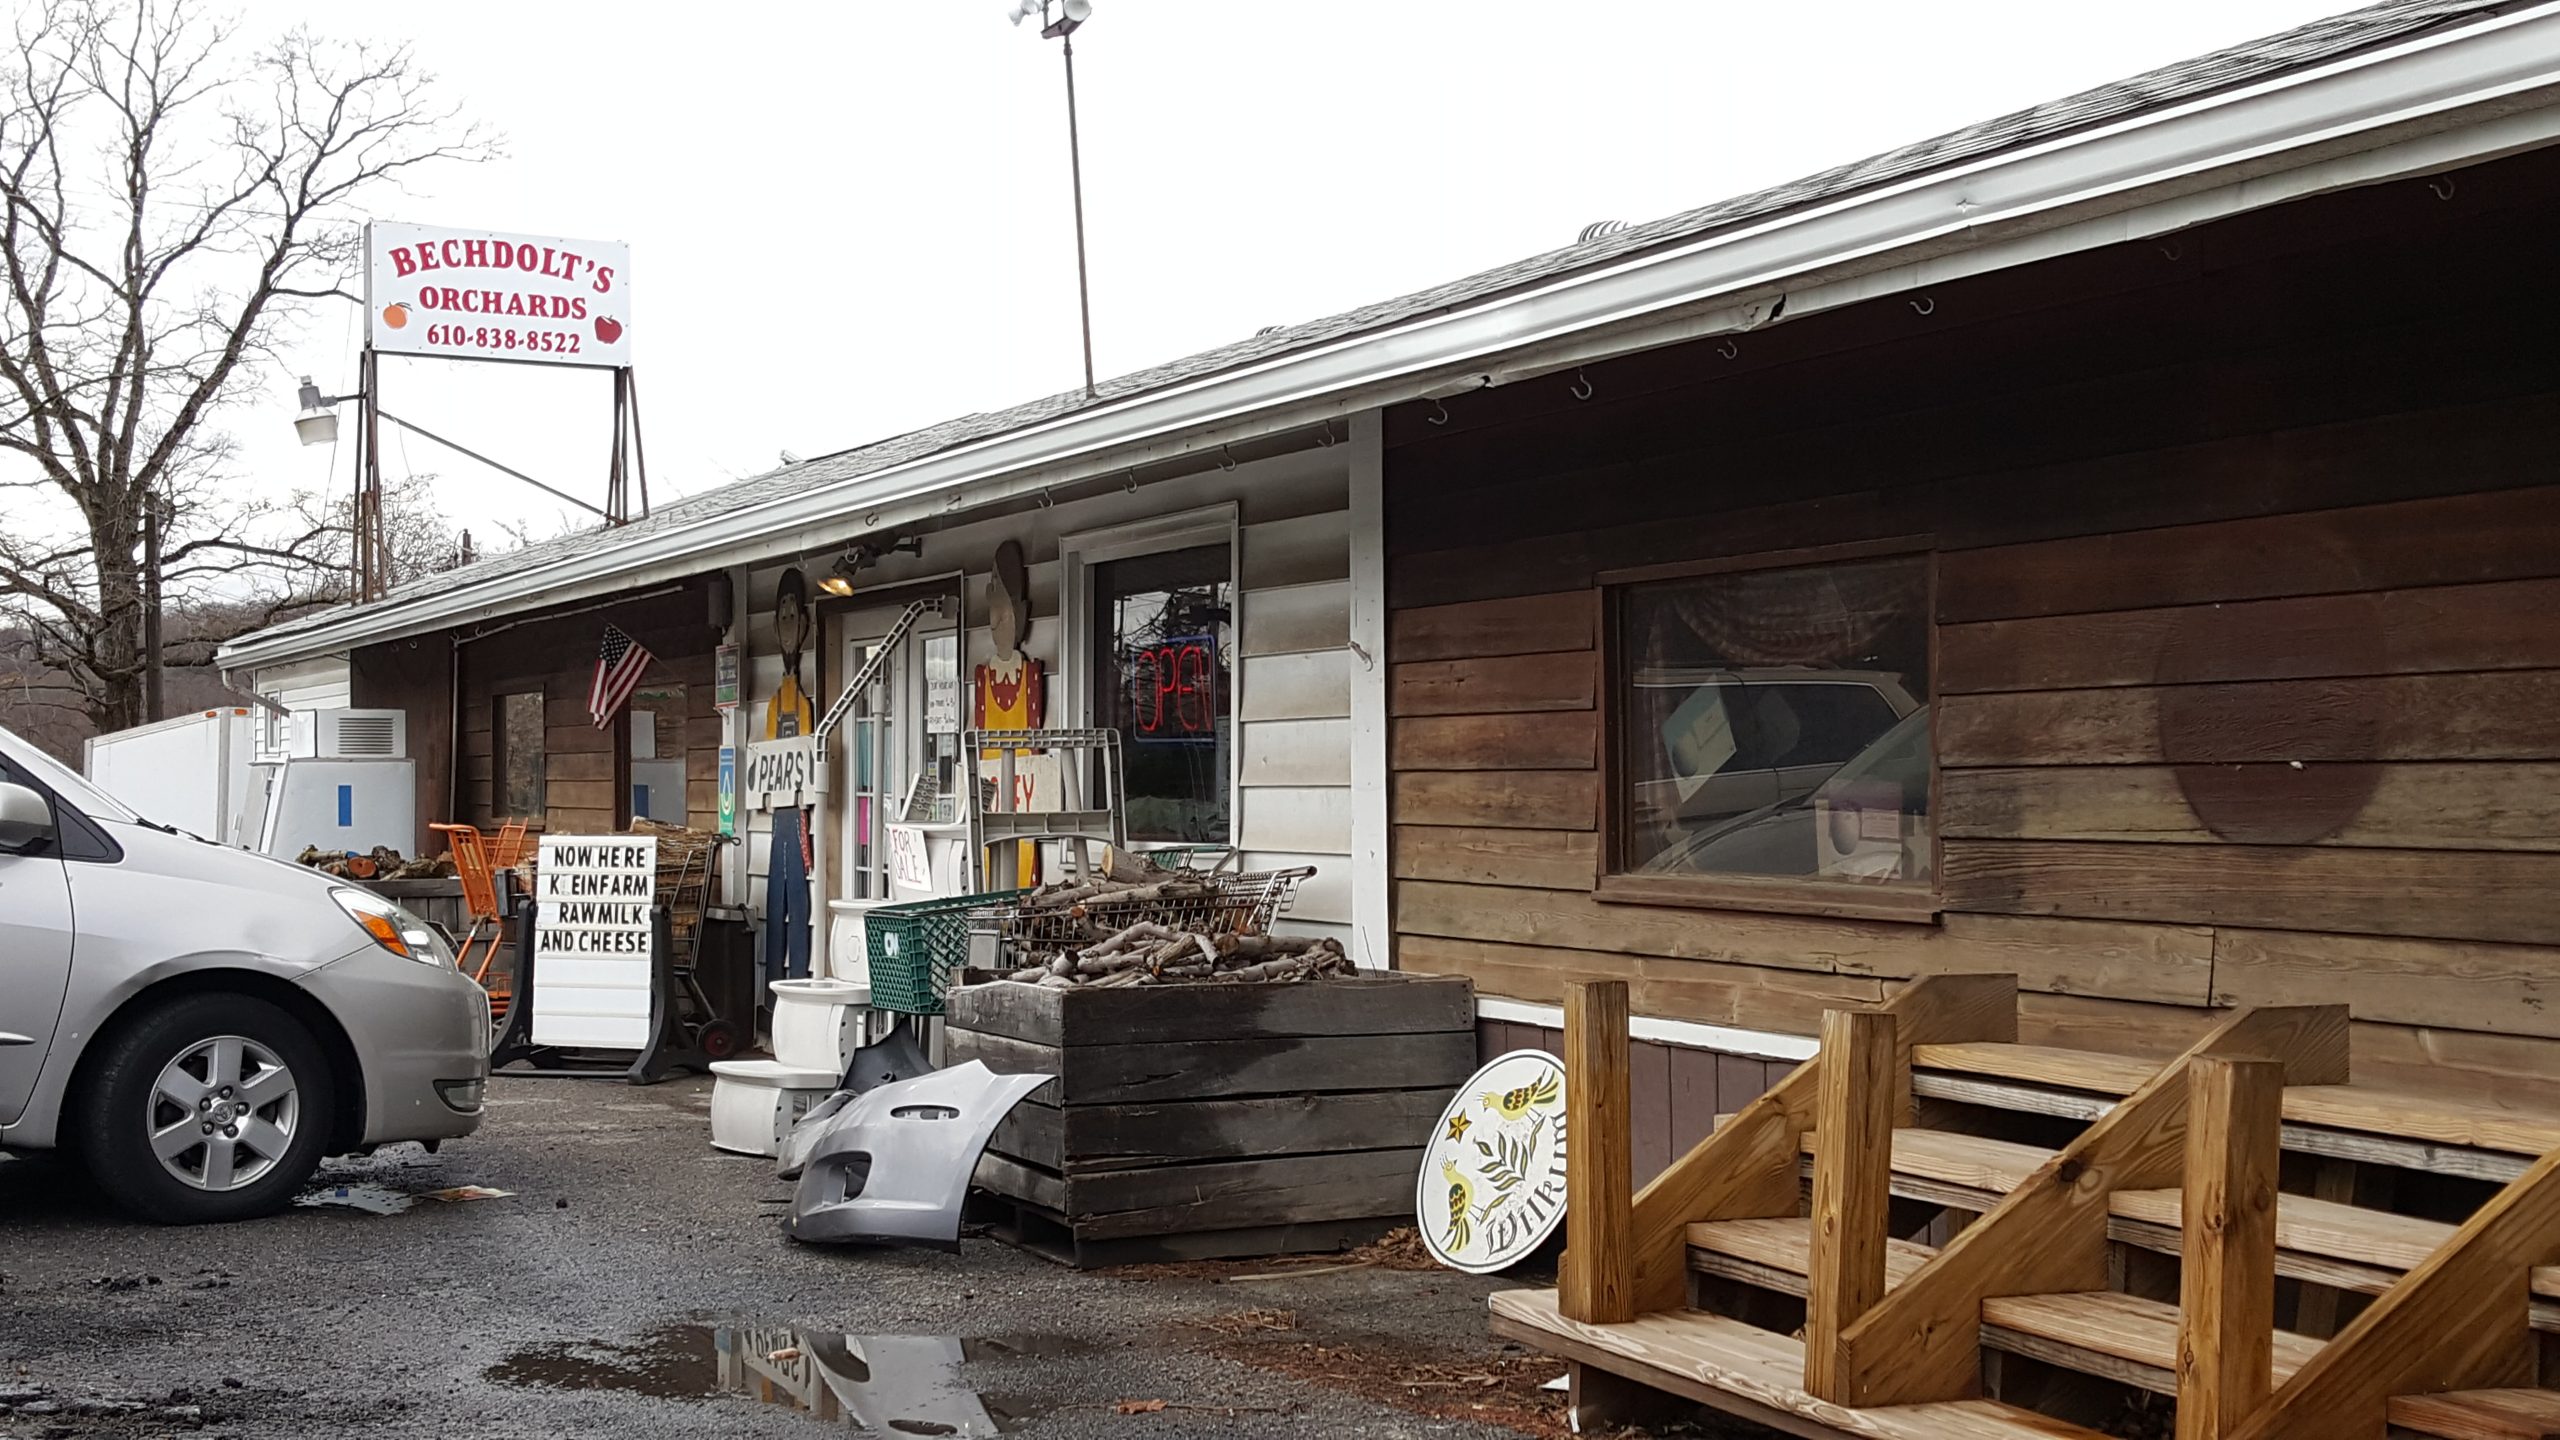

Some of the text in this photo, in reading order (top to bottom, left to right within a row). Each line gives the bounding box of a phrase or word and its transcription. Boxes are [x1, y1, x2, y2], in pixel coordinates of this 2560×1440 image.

[388, 239, 615, 294] BECHDOLT'S
[418, 286, 588, 320] ORCHARDS
[426, 323, 581, 354] 610-838-8522
[1135, 645, 1214, 733] OPEN
[757, 750, 804, 793] PEARS
[892, 828, 913, 854] FOR
[893, 849, 922, 884] SALE
[541, 930, 647, 953] AND CHEESE
